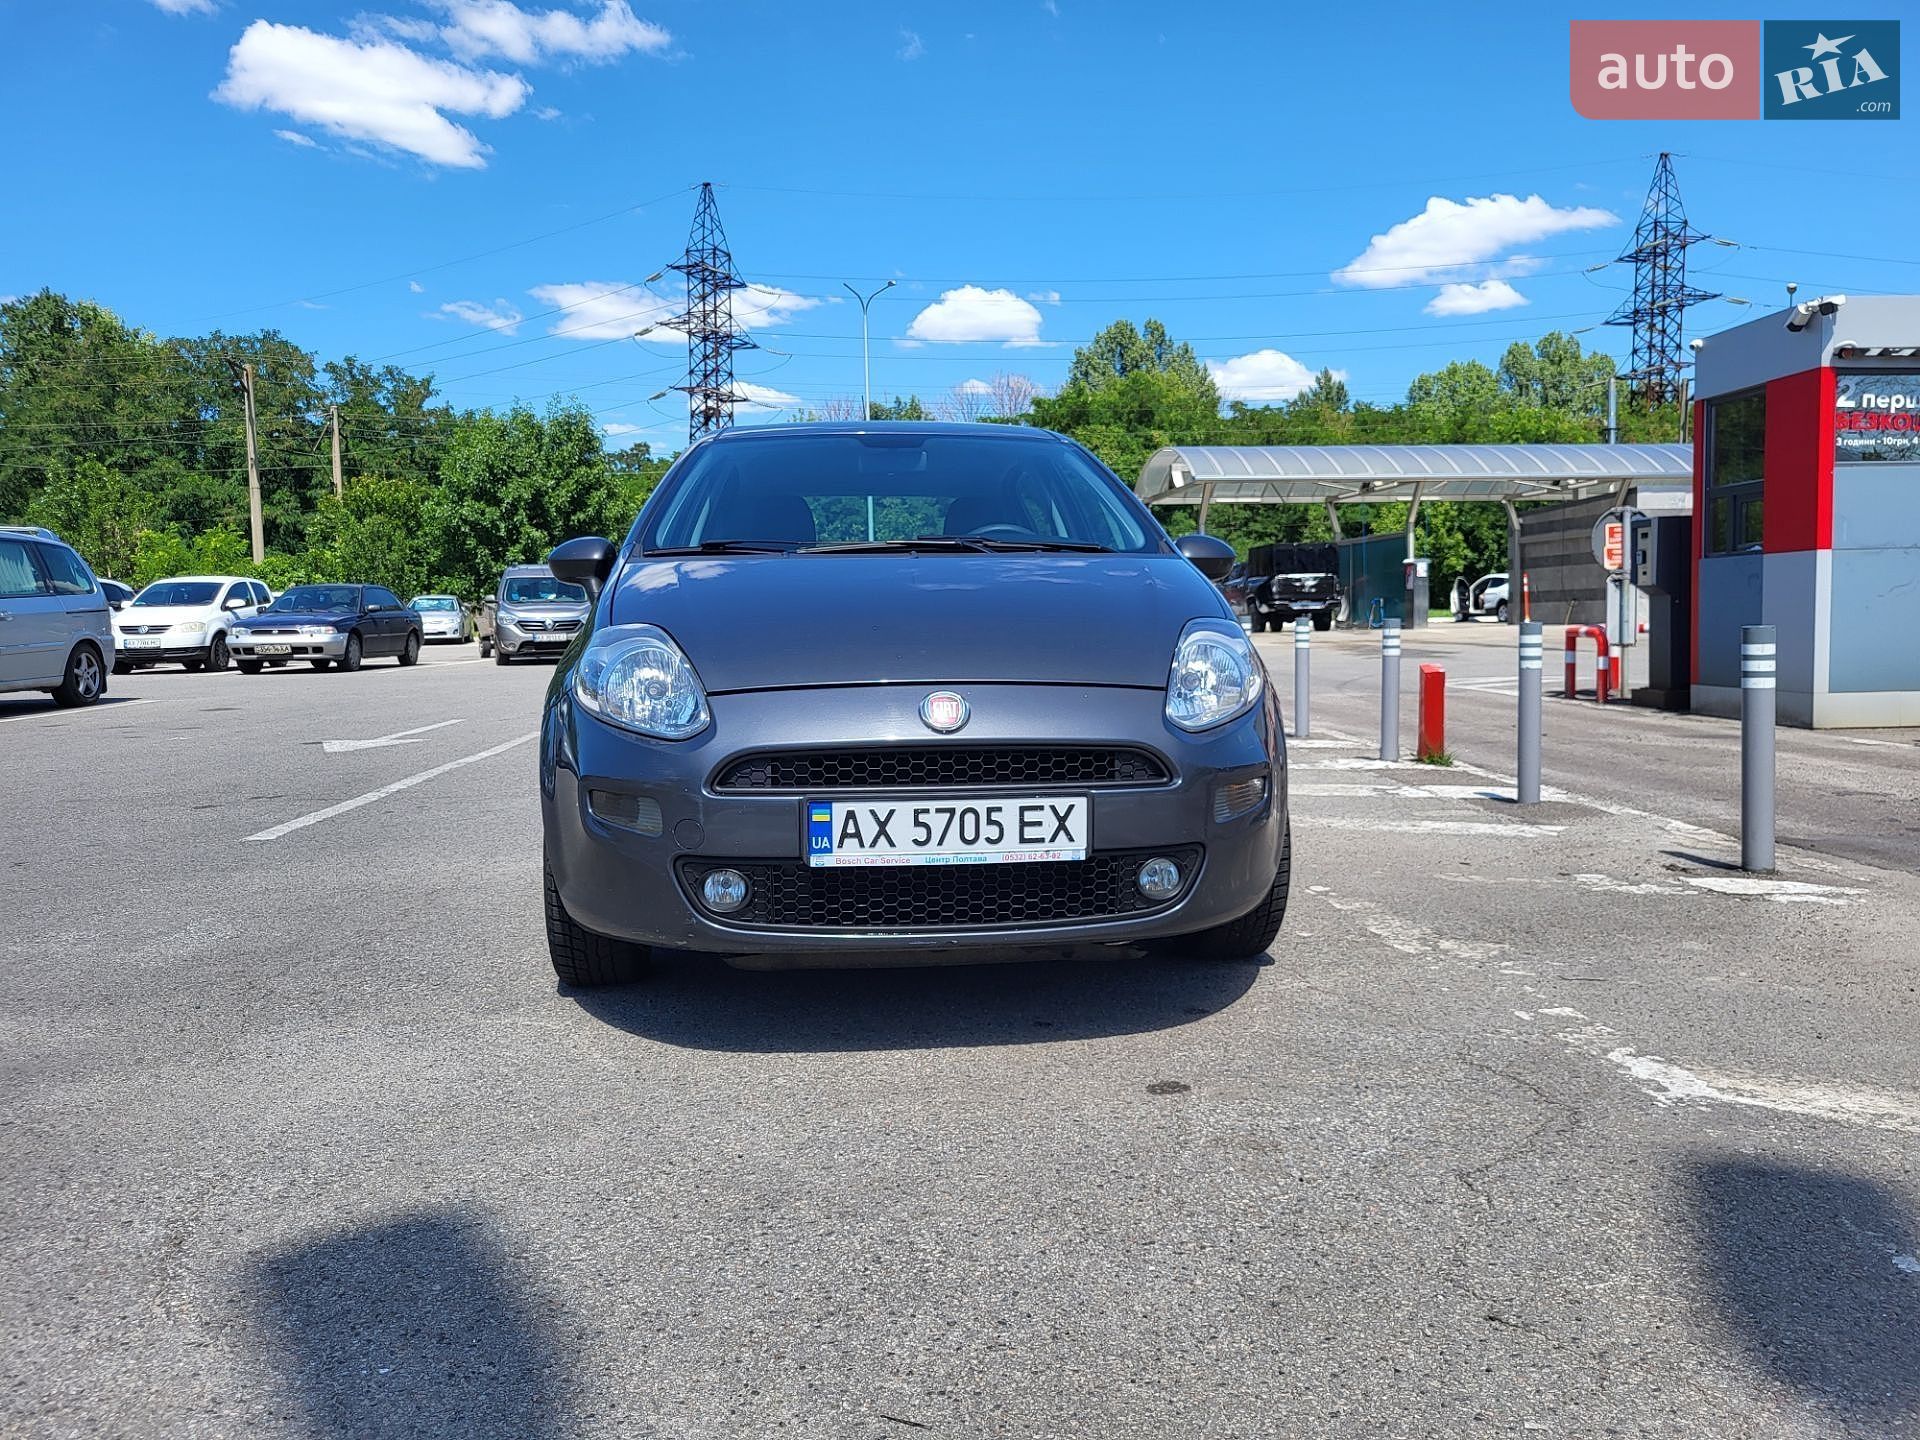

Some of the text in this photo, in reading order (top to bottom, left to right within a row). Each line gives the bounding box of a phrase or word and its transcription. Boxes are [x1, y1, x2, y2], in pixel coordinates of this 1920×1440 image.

[1836, 379, 1856, 408] 2
[1843, 437, 1876, 446] години
[837, 804, 1076, 848] AX 5705 EX
[812, 836, 831, 849] UA
[835, 855, 911, 865] Bosch Car Service
[925, 854, 988, 865] Центр Полтава
[1001, 852, 1026, 862] (0532)
